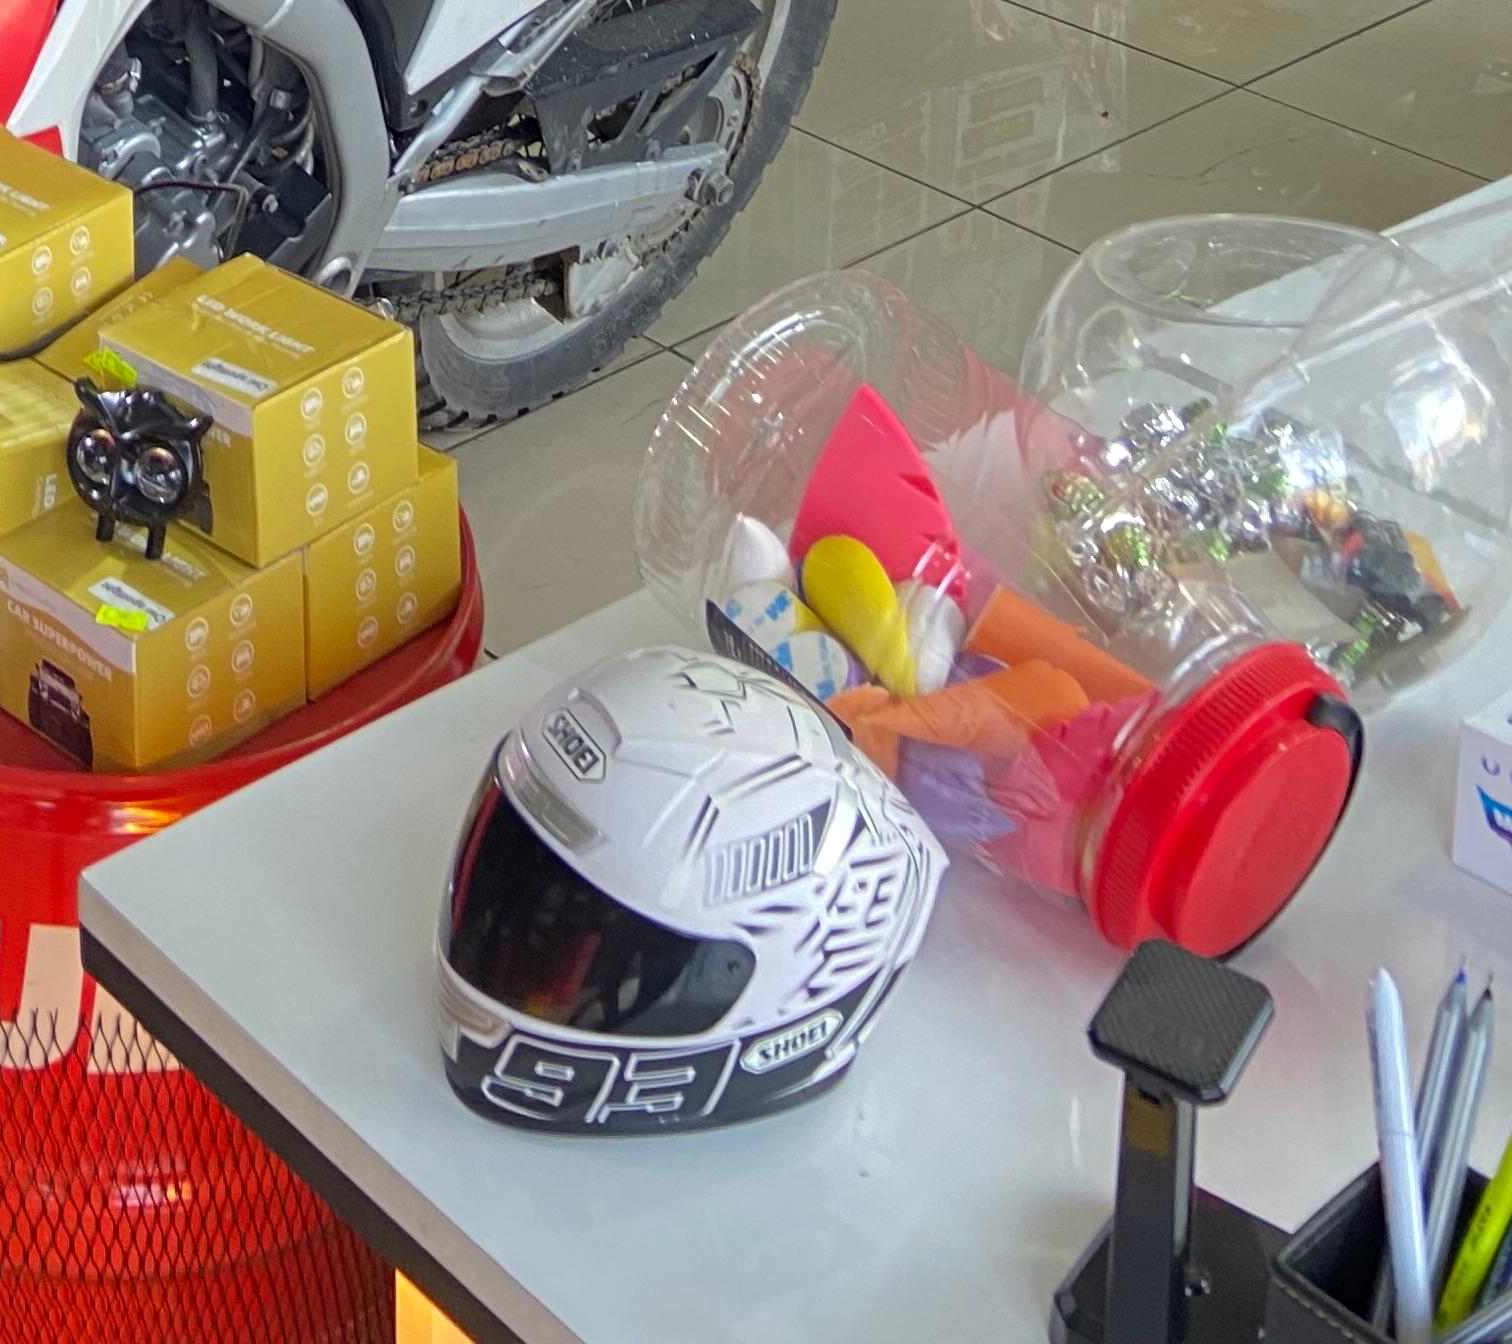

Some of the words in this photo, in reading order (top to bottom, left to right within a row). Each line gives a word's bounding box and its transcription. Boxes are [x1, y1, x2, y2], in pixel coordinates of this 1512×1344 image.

[197, 295, 225, 311] LED
[224, 308, 270, 334] WORK
[44, 474, 58, 510] LED
[8, 600, 30, 625] CAR
[33, 616, 113, 682] SUPERPOWER
[547, 711, 600, 774] SHOEI
[758, 1021, 832, 1063] SHOEI
